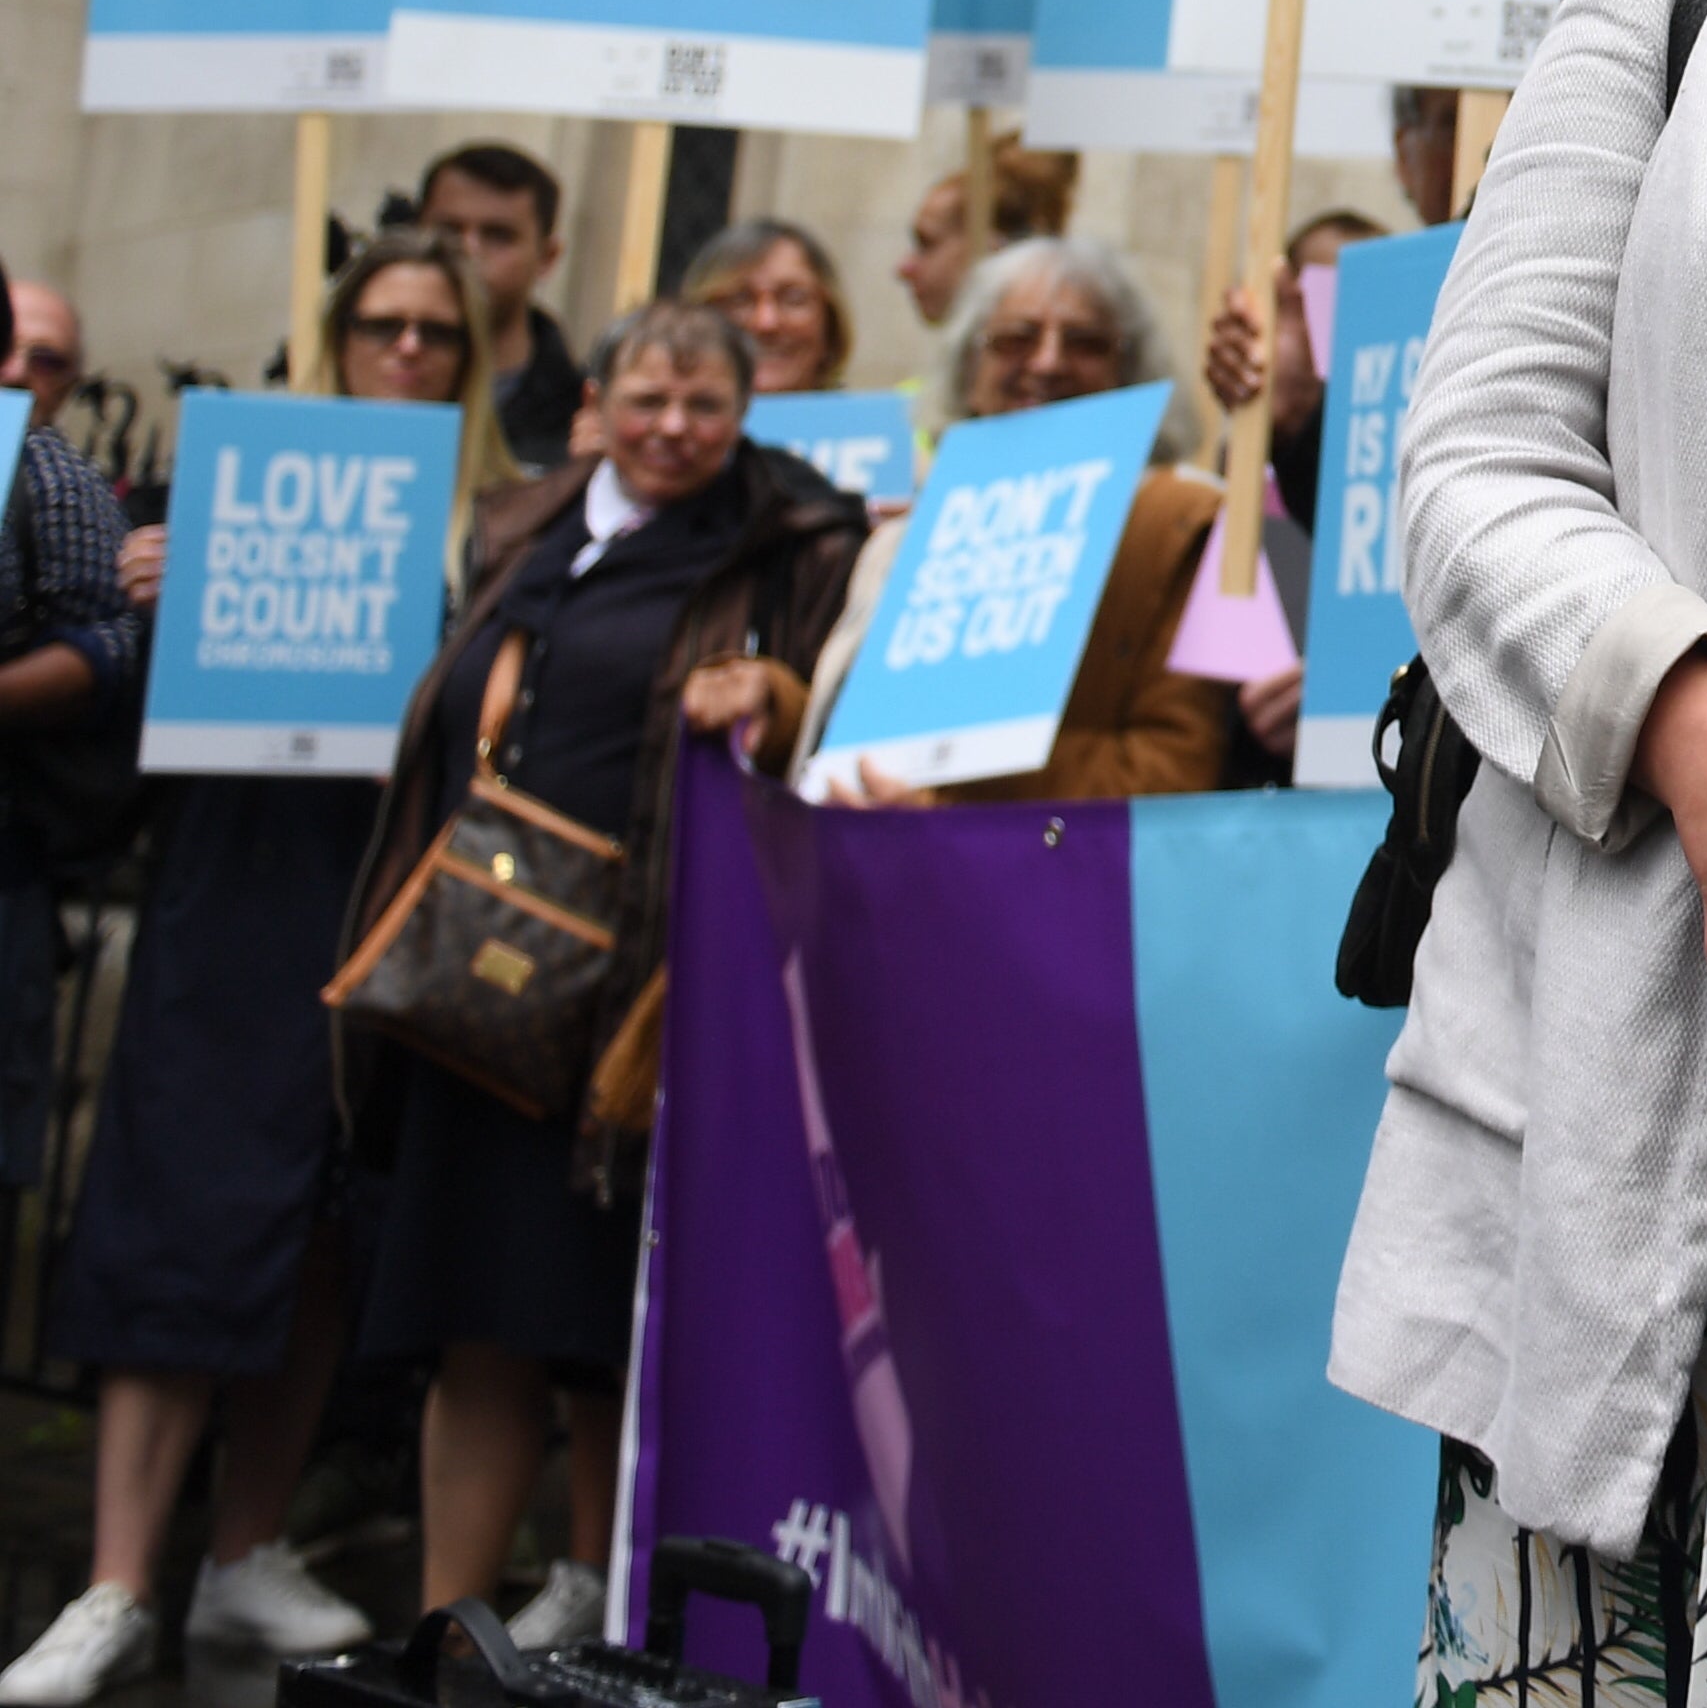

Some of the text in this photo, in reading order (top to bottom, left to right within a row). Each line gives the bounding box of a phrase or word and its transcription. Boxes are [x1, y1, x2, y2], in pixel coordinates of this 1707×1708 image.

[212, 444, 417, 536] LOVE
[927, 458, 1113, 554] DON'T
[206, 529, 405, 587] DOESN'T
[200, 578, 400, 643] COUNT
[884, 585, 1069, 671] US OUT
